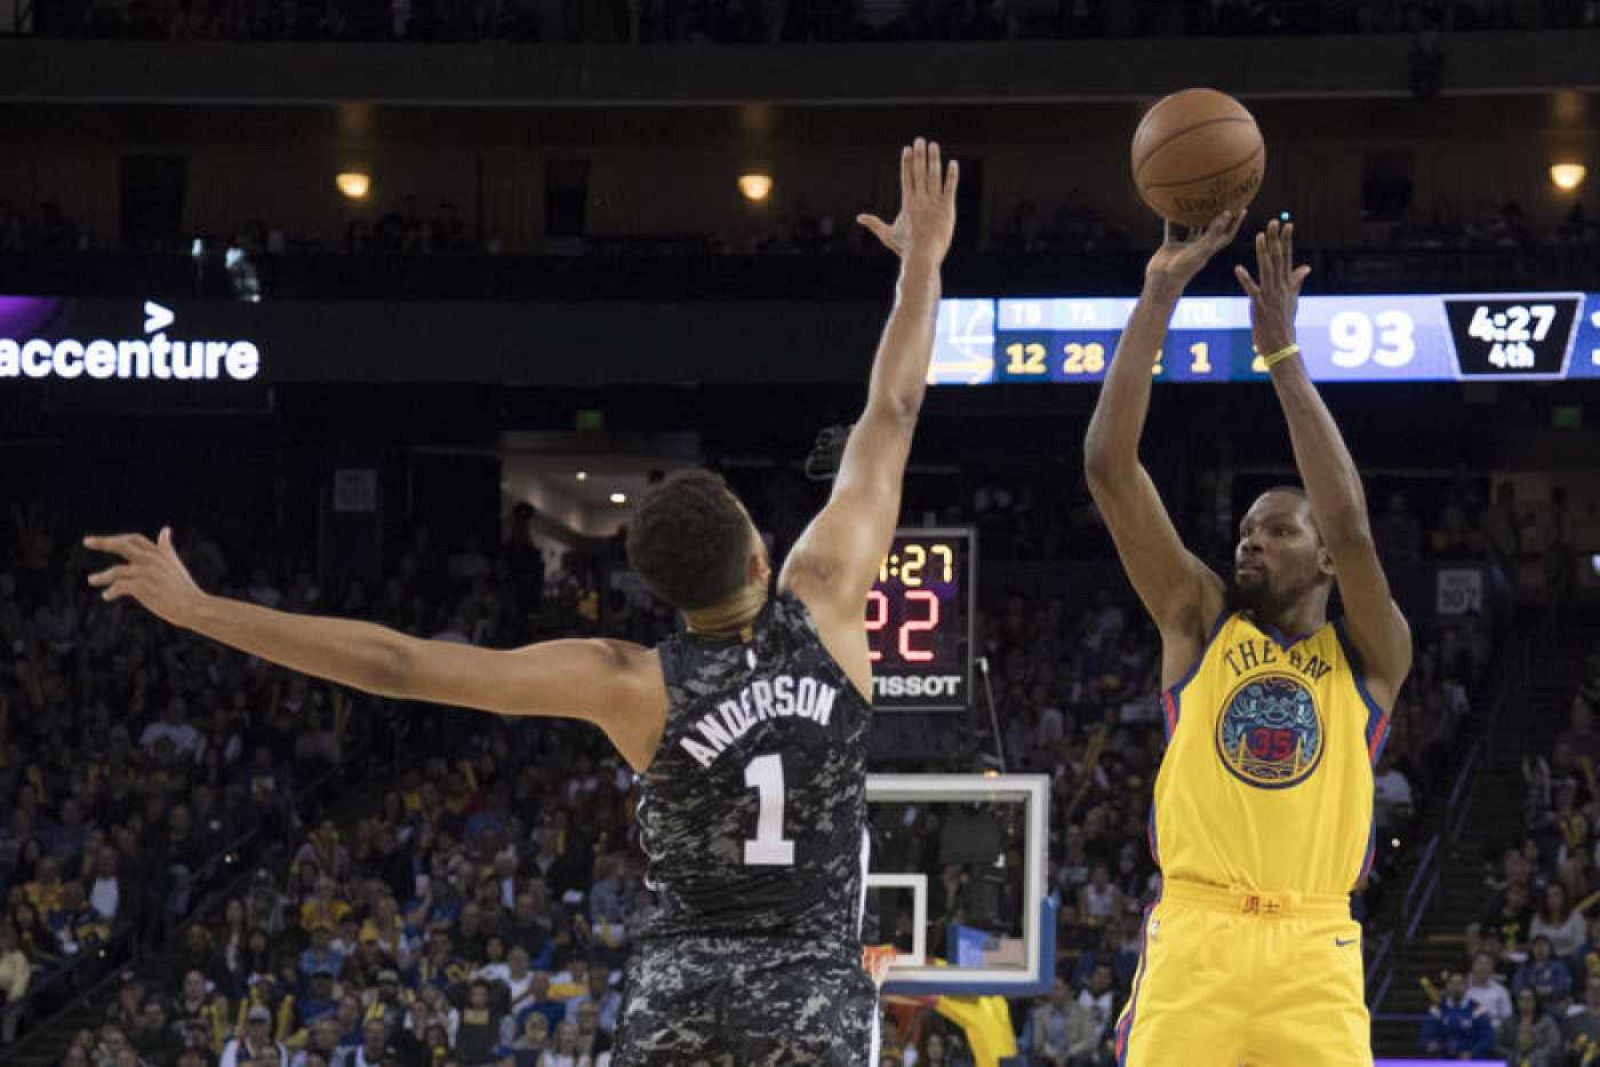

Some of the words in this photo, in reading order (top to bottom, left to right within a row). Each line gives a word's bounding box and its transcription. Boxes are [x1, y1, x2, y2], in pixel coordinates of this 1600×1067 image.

[1329, 310, 1416, 369] 93
[1467, 305, 1557, 342] 4:27
[0, 332, 260, 379] accenture
[1006, 342, 1047, 374] 12
[1063, 342, 1105, 375] 28
[1189, 342, 1212, 373] 1
[1487, 342, 1535, 368] 4th
[864, 589, 939, 662] 22
[1224, 639, 1277, 677] THE
[679, 674, 837, 768] ANDERSON
[1249, 726, 1293, 761] 35
[743, 753, 795, 865] 1
